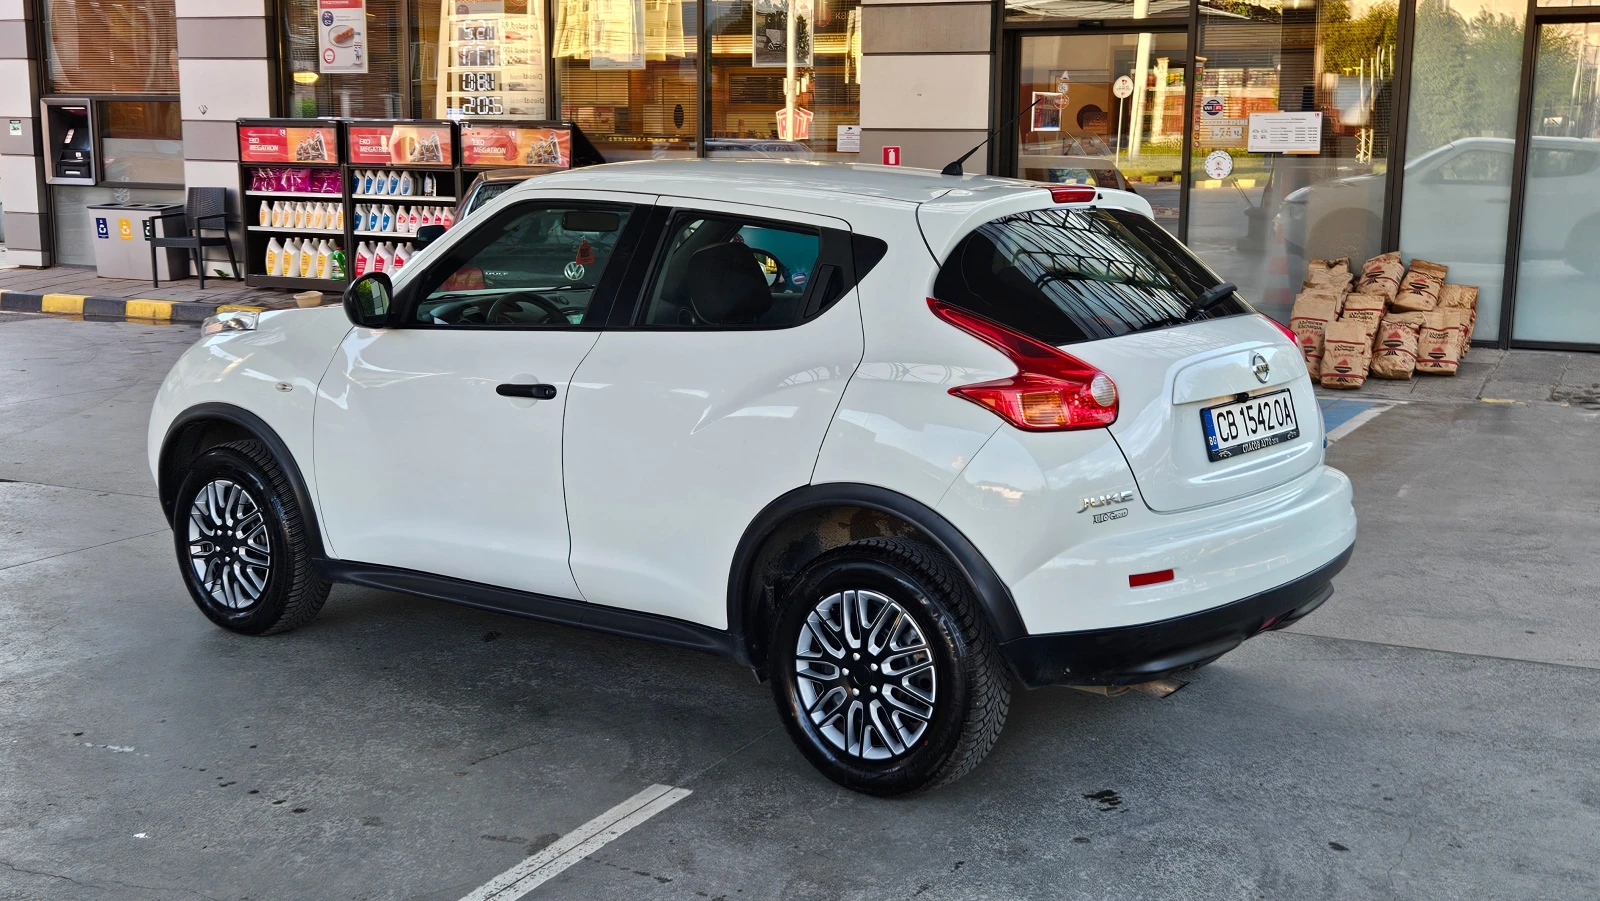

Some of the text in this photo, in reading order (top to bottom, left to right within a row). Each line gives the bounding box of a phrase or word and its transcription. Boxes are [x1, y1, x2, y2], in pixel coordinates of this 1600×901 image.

[473, 146, 507, 154] MEGATRON
[1216, 397, 1293, 442] CB 1542 OA
[1208, 436, 1217, 446] BG
[1076, 490, 1134, 514] JUKE
